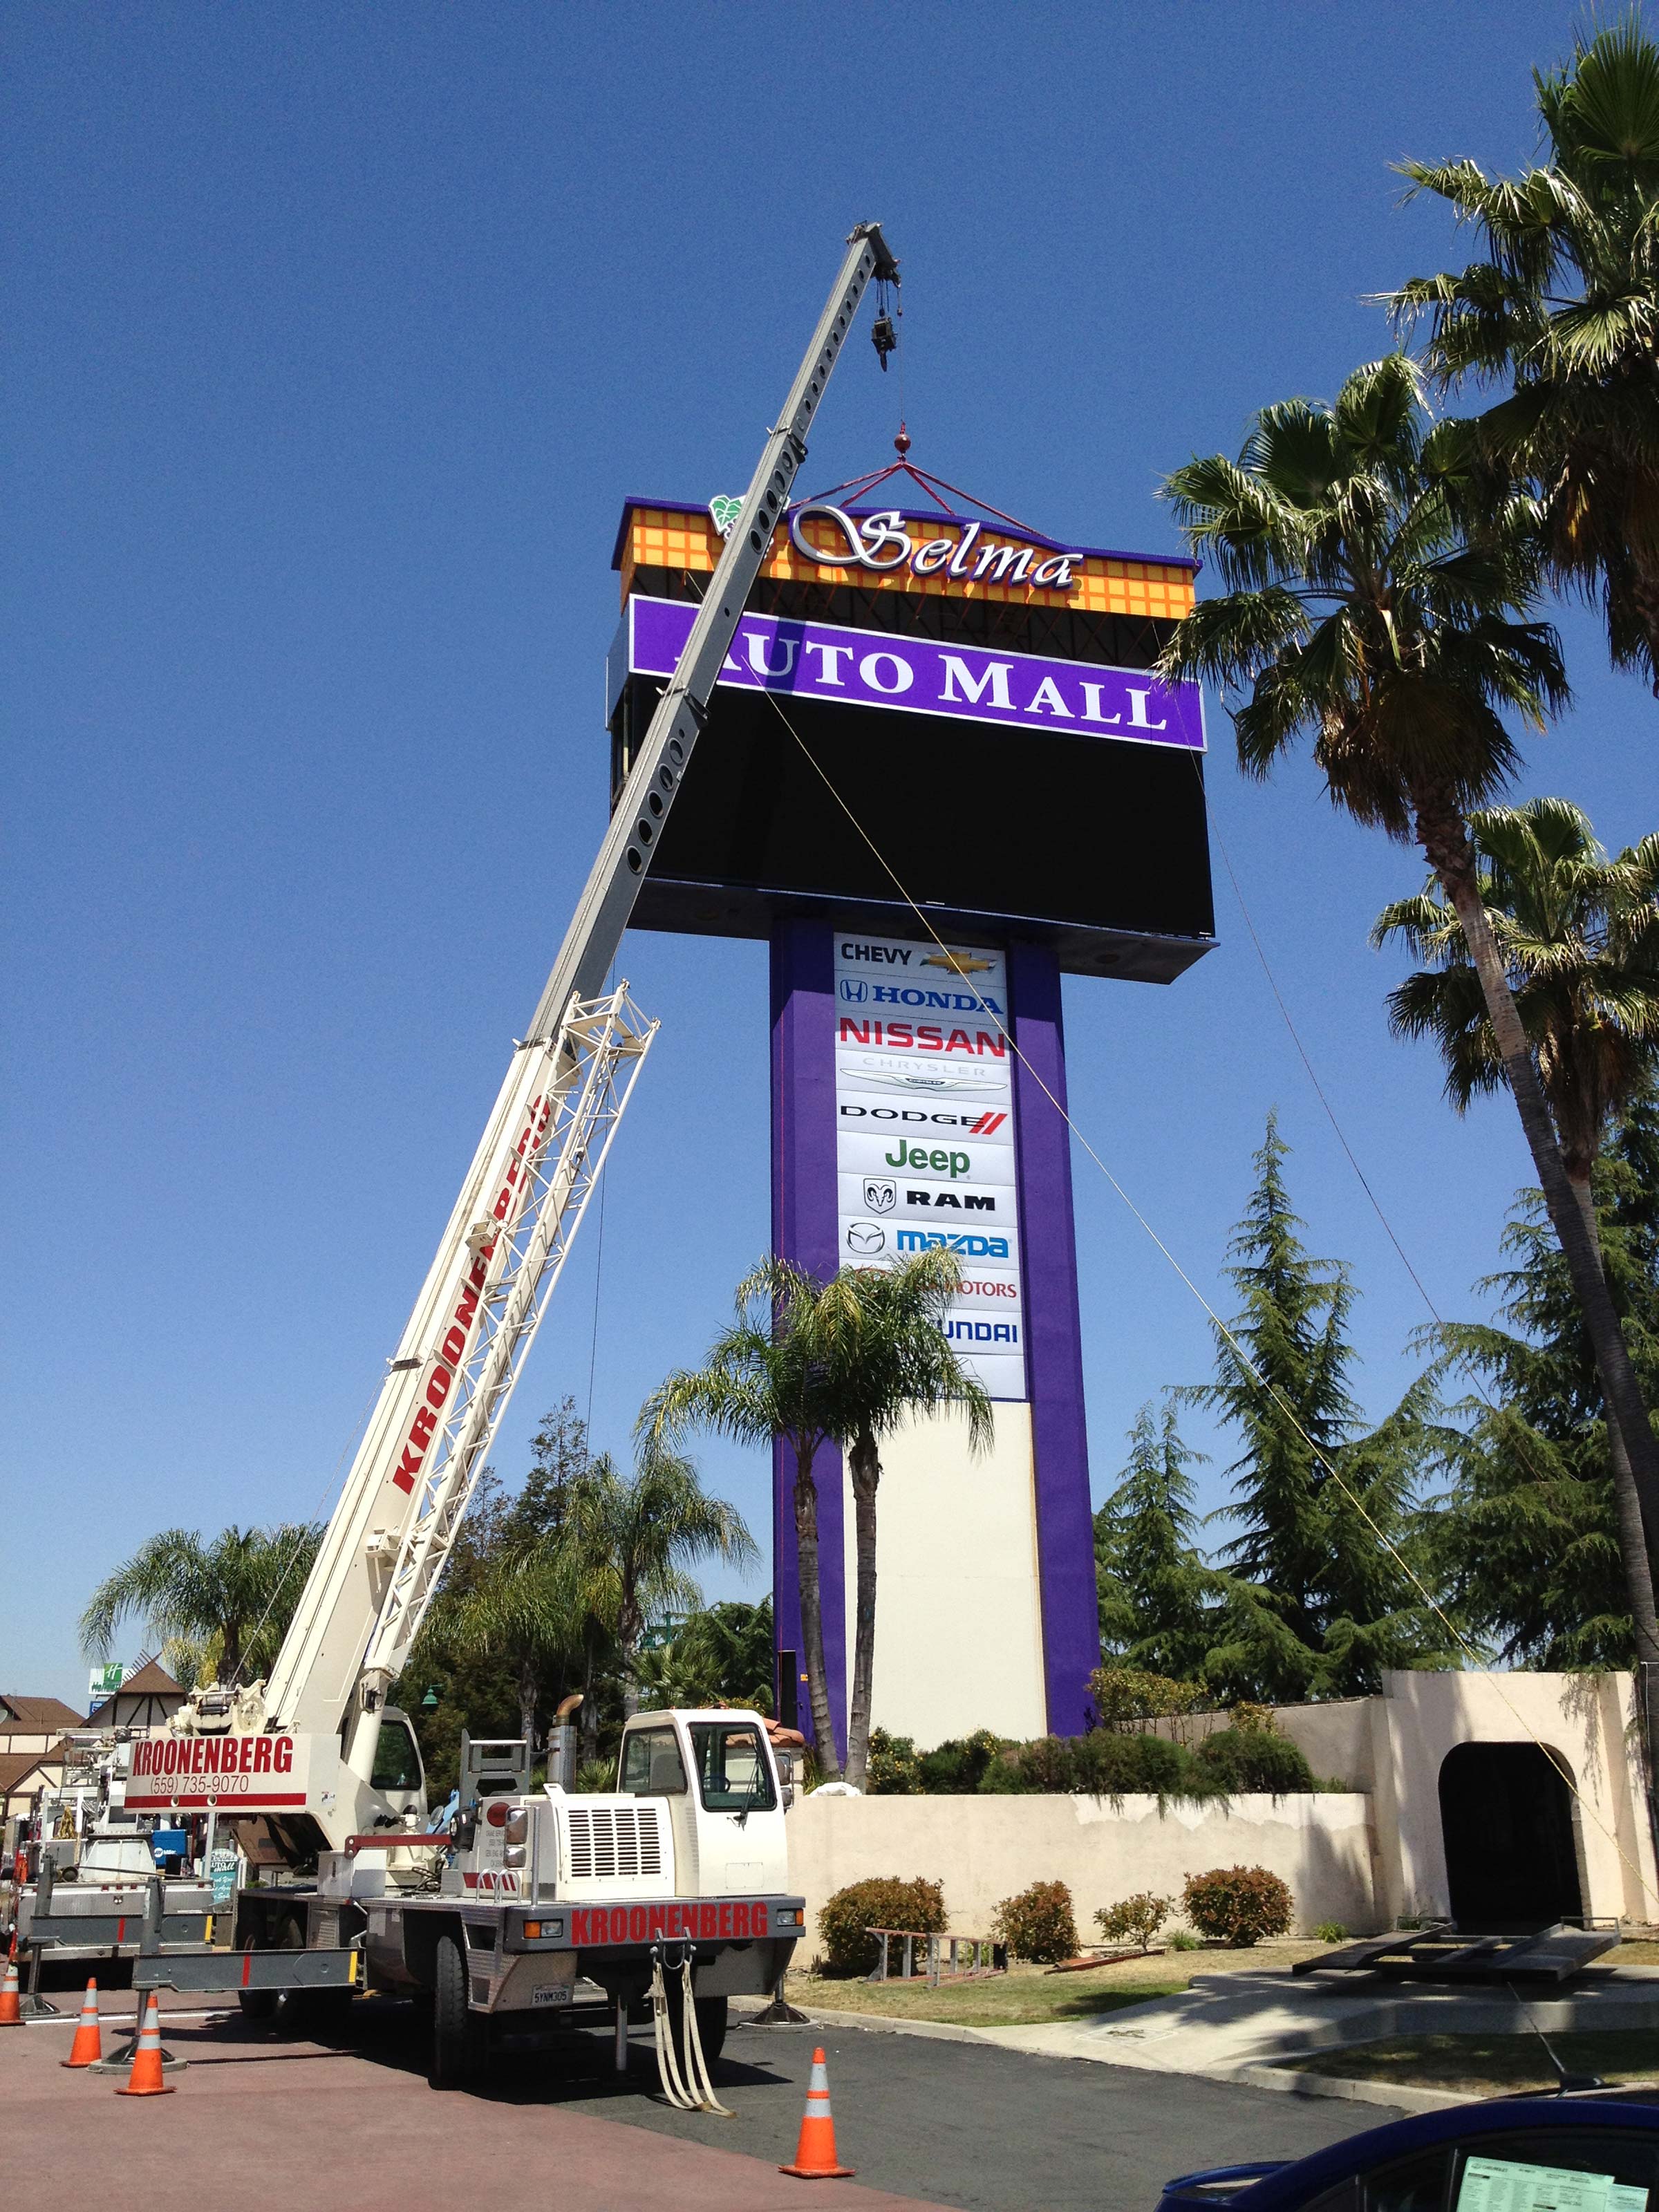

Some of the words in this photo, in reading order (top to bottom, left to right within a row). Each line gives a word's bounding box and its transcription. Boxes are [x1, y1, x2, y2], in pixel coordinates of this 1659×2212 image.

[791, 504, 1085, 589] Selma
[938, 654, 1168, 731] MALL
[841, 942, 912, 966] CHEVY
[873, 985, 1004, 1015] HONDA
[839, 1017, 1006, 1058] NISSAN
[862, 1057, 986, 1077] CHRYSLER
[840, 1105, 985, 1127] DODGE
[885, 1139, 971, 1179] Jeep
[906, 1190, 996, 1212] RAM
[132, 1736, 294, 1777] KROONENBERG
[150, 1776, 180, 1795] (559)
[182, 1774, 250, 1794] 735-9070
[571, 1901, 768, 1946] KROONENBERG
